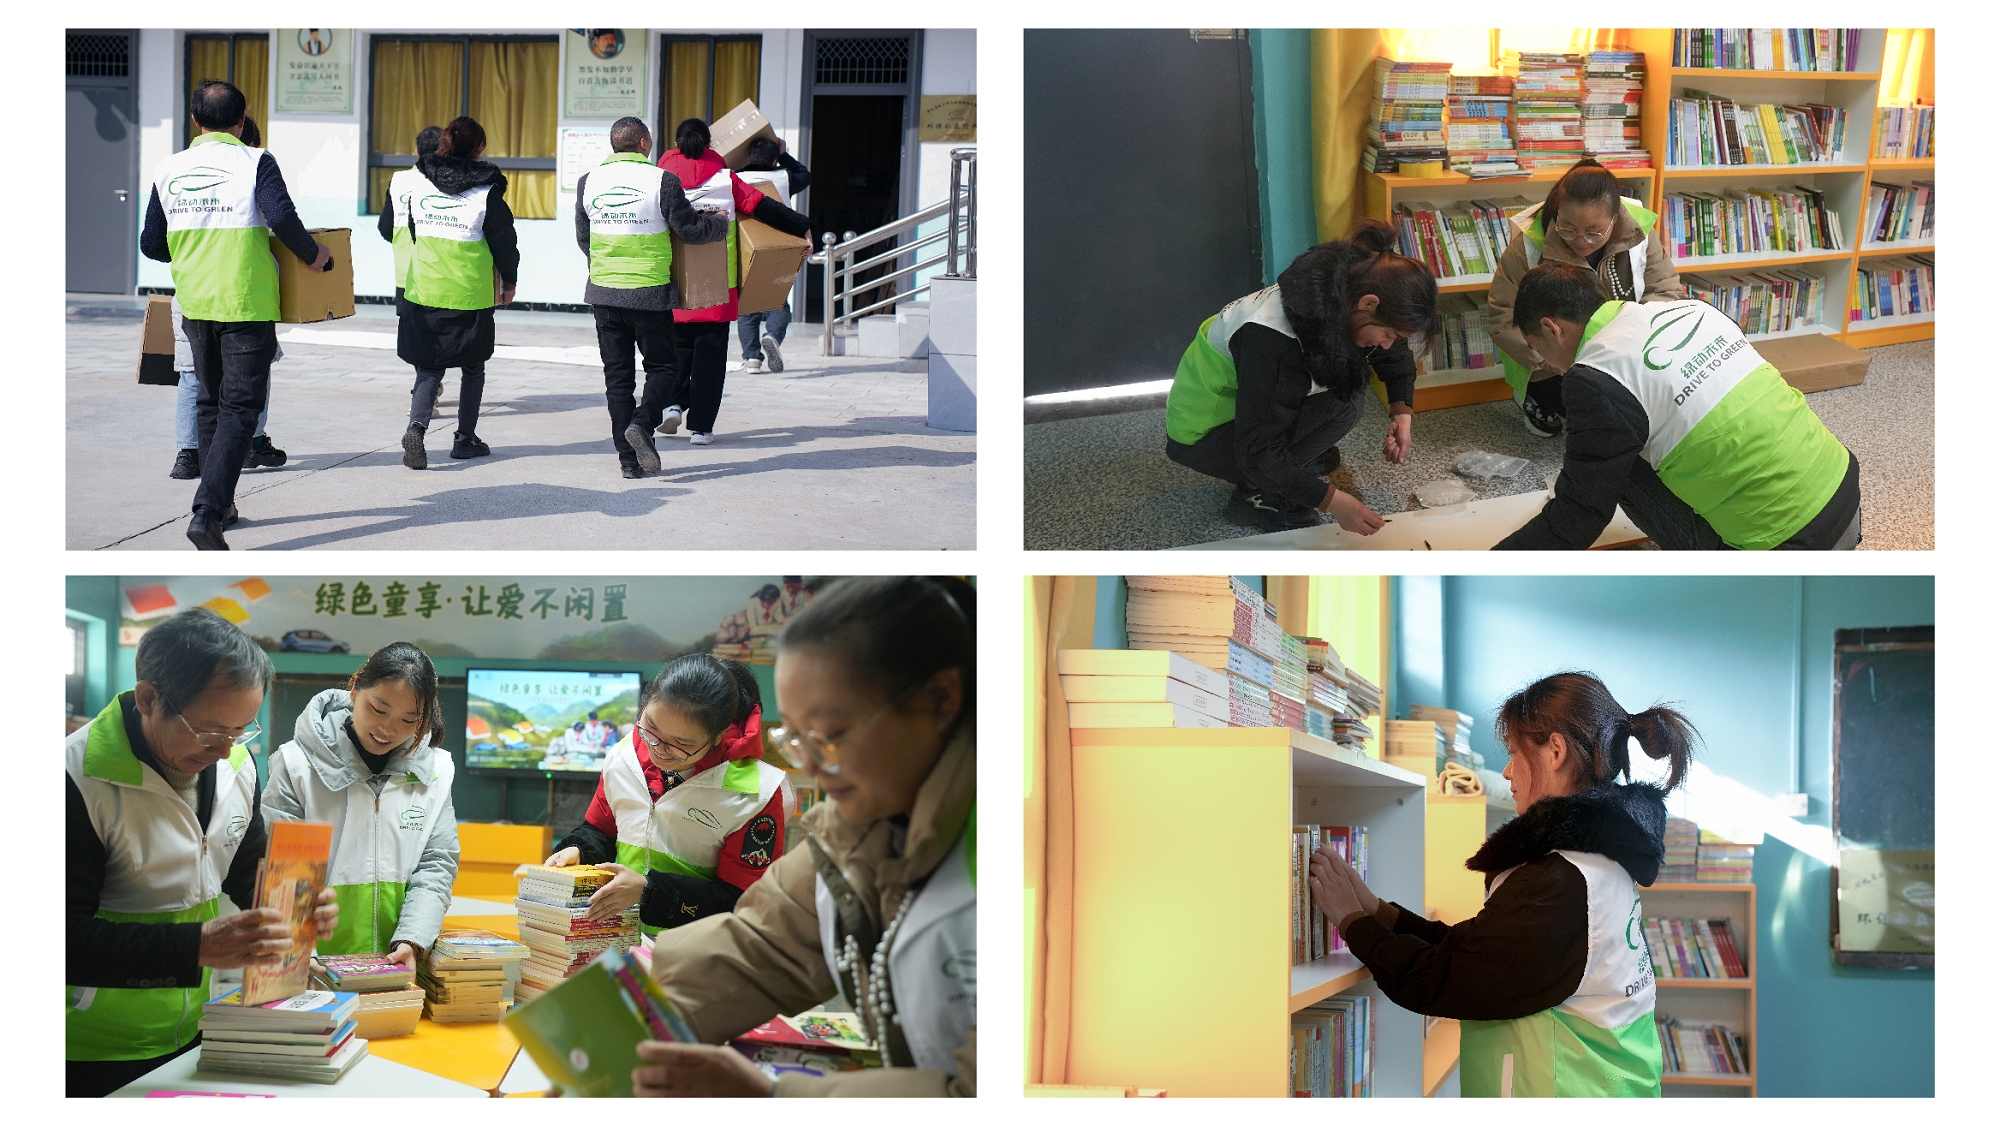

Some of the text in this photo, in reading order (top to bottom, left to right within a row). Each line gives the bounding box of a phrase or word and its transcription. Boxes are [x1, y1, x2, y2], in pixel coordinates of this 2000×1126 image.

[1674, 338, 1748, 406] DRIVE TO GREEN
